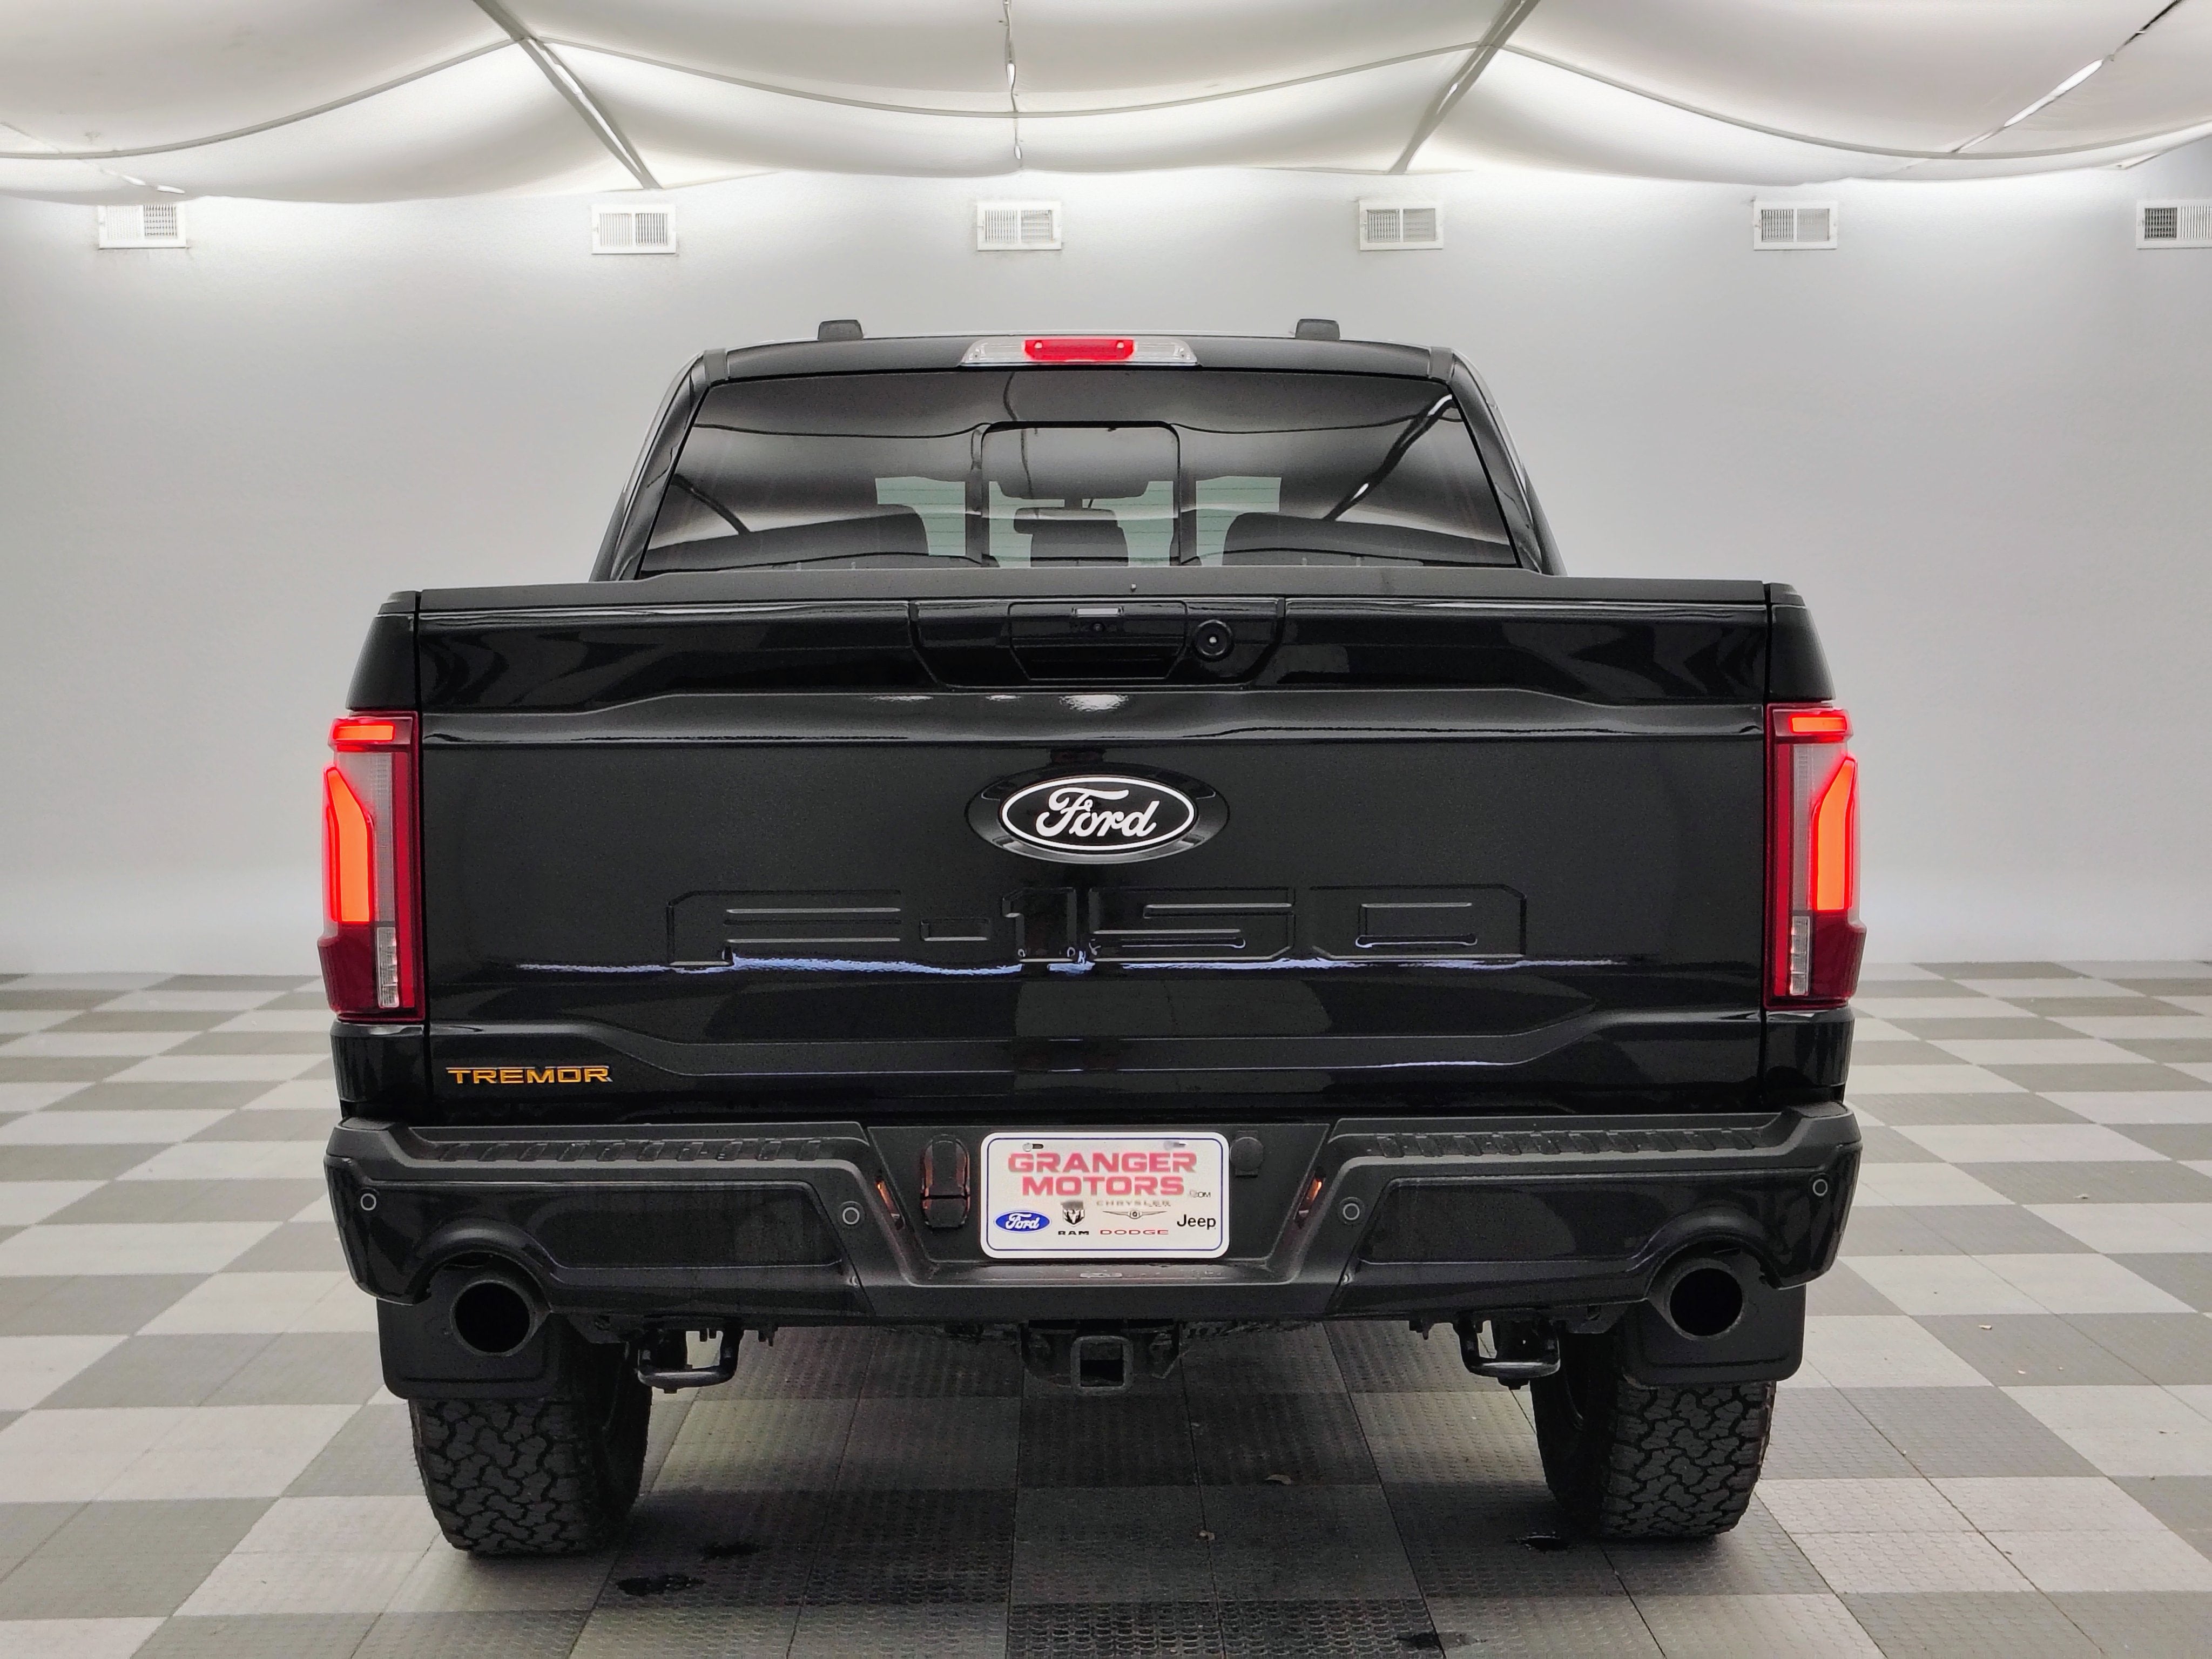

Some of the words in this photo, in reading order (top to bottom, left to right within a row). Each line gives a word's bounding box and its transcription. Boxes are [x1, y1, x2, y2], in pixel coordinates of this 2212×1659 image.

[1036, 787, 1159, 837] Ford
[445, 1065, 612, 1084] TREMOR
[1008, 1152, 1197, 1173] GRANGER
[1022, 1176, 1184, 1196] MOTORS
[1005, 1213, 1040, 1230] Ford
[1177, 1214, 1216, 1230] Jeep
